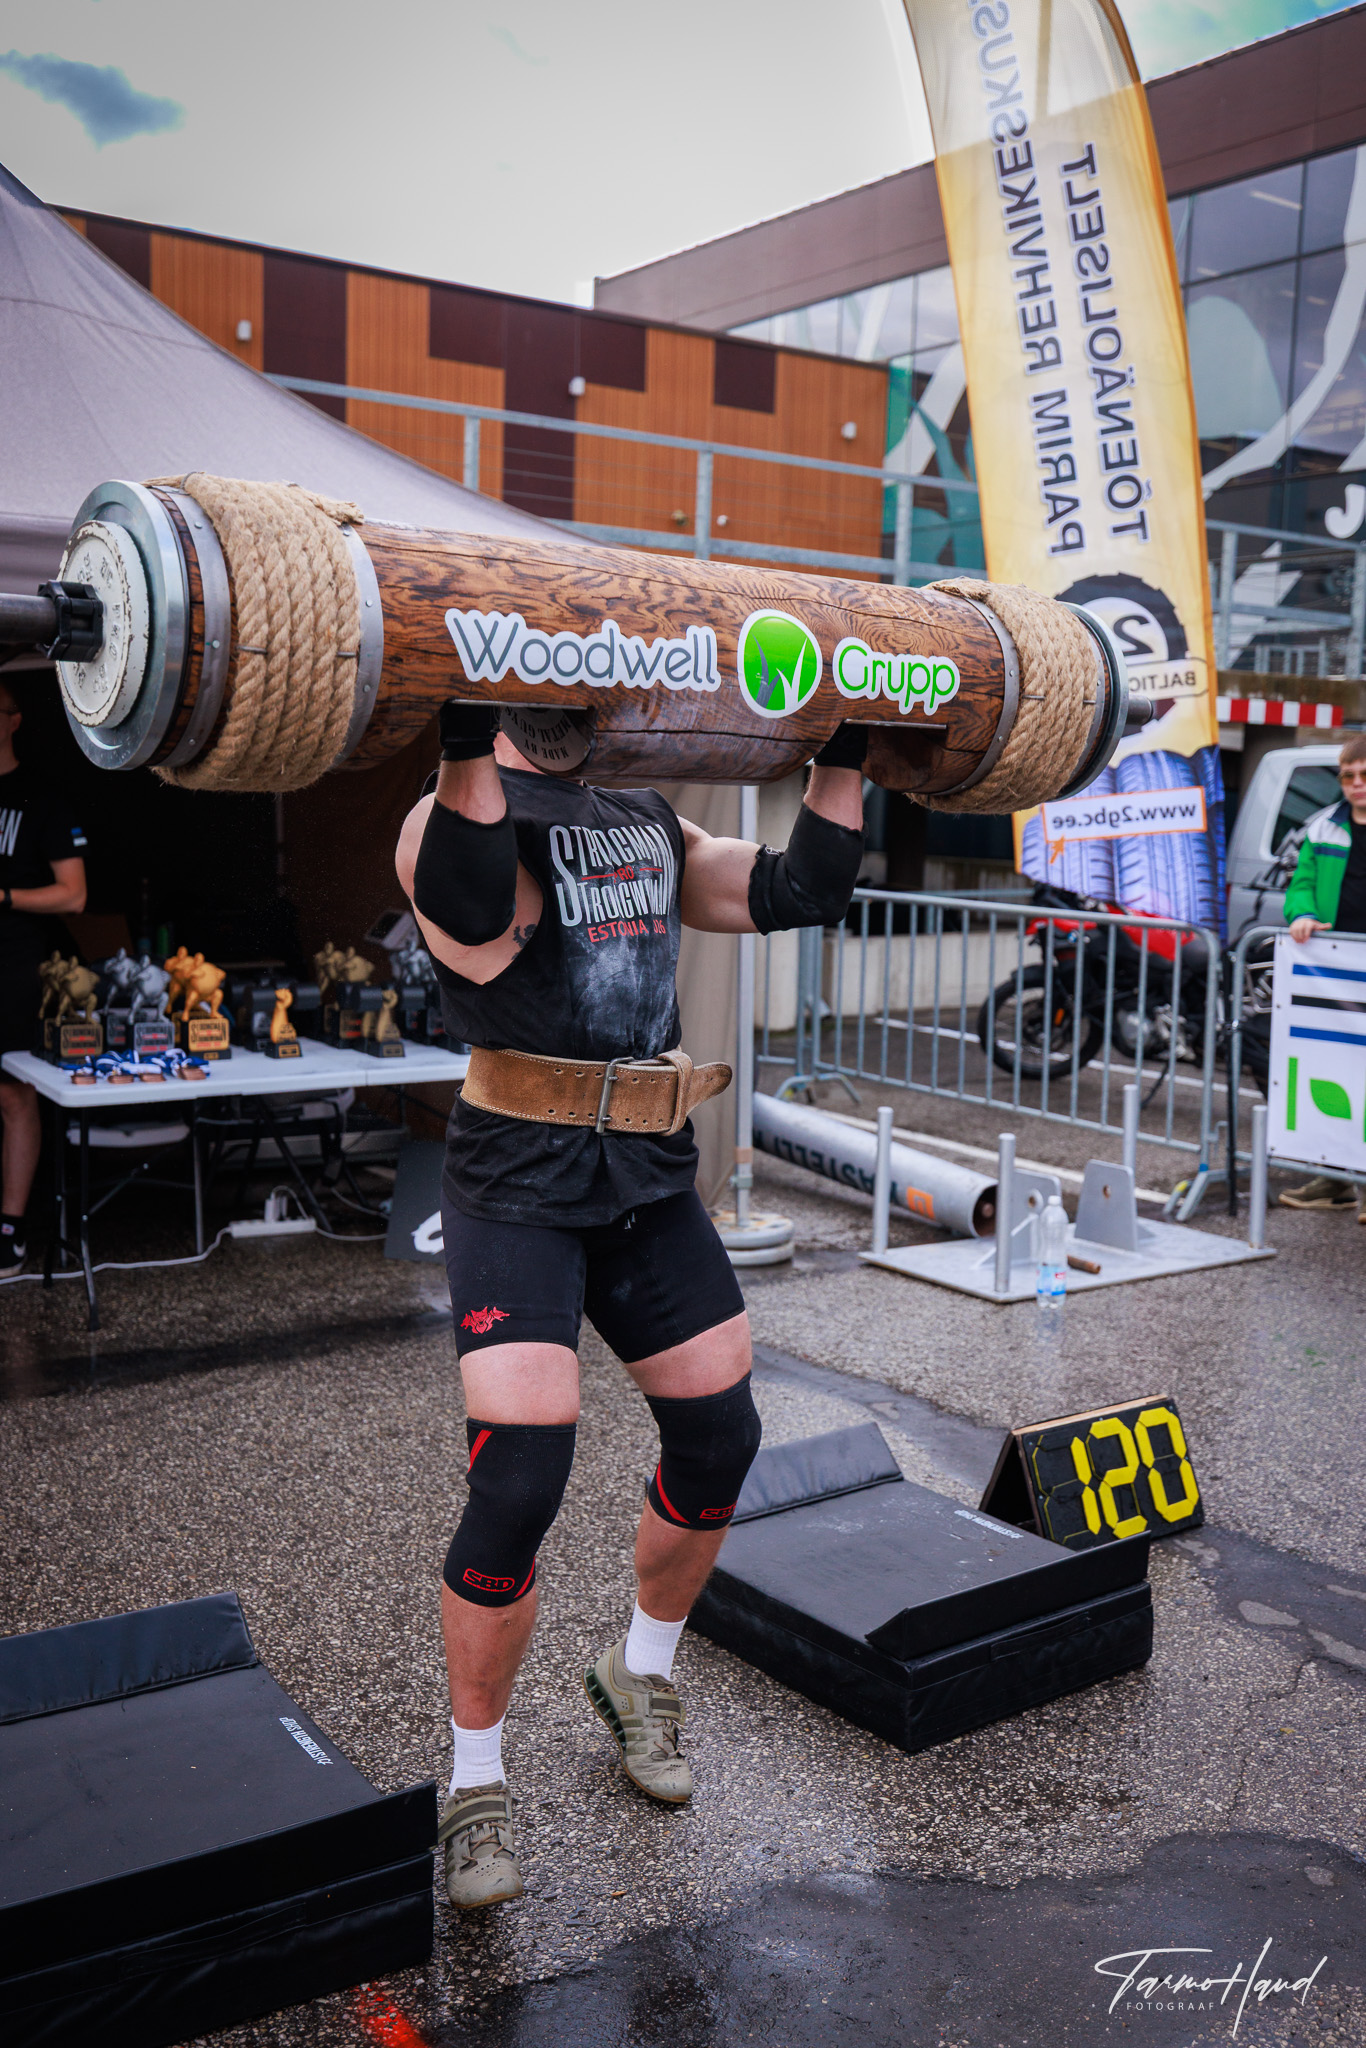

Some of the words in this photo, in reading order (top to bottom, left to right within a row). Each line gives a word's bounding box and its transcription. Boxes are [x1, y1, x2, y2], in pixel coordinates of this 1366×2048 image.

[452, 617, 716, 686] Woodwell
[837, 644, 956, 710] Grupp
[537, 714, 573, 743] METAL
[524, 739, 538, 755] BY
[541, 746, 569, 760] MADE
[587, 919, 649, 943] ESTONIA
[1070, 1406, 1199, 1540] 120
[463, 1568, 515, 1592] SBD
